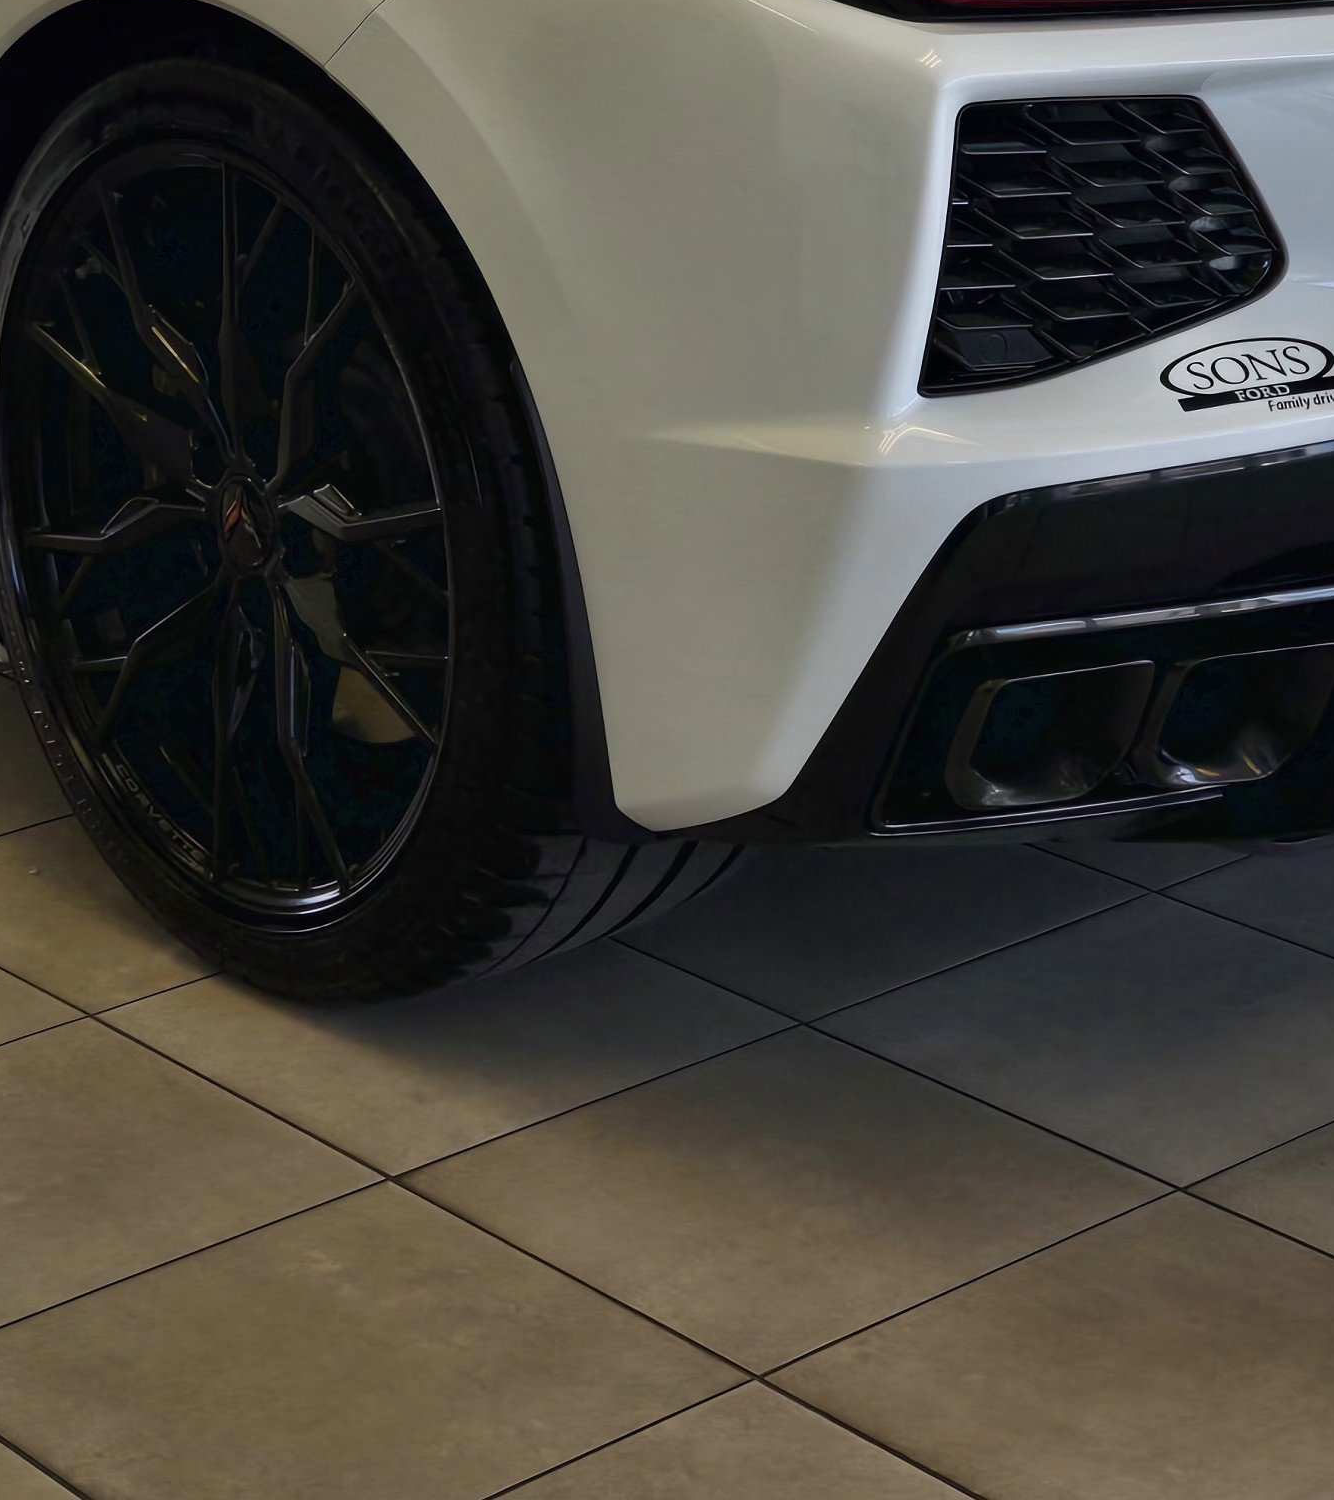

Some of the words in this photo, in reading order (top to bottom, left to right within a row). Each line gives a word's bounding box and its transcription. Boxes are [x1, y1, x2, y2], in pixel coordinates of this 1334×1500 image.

[1186, 345, 1310, 390] SONS
[1234, 384, 1291, 402] FORD
[1268, 395, 1311, 412] Family
